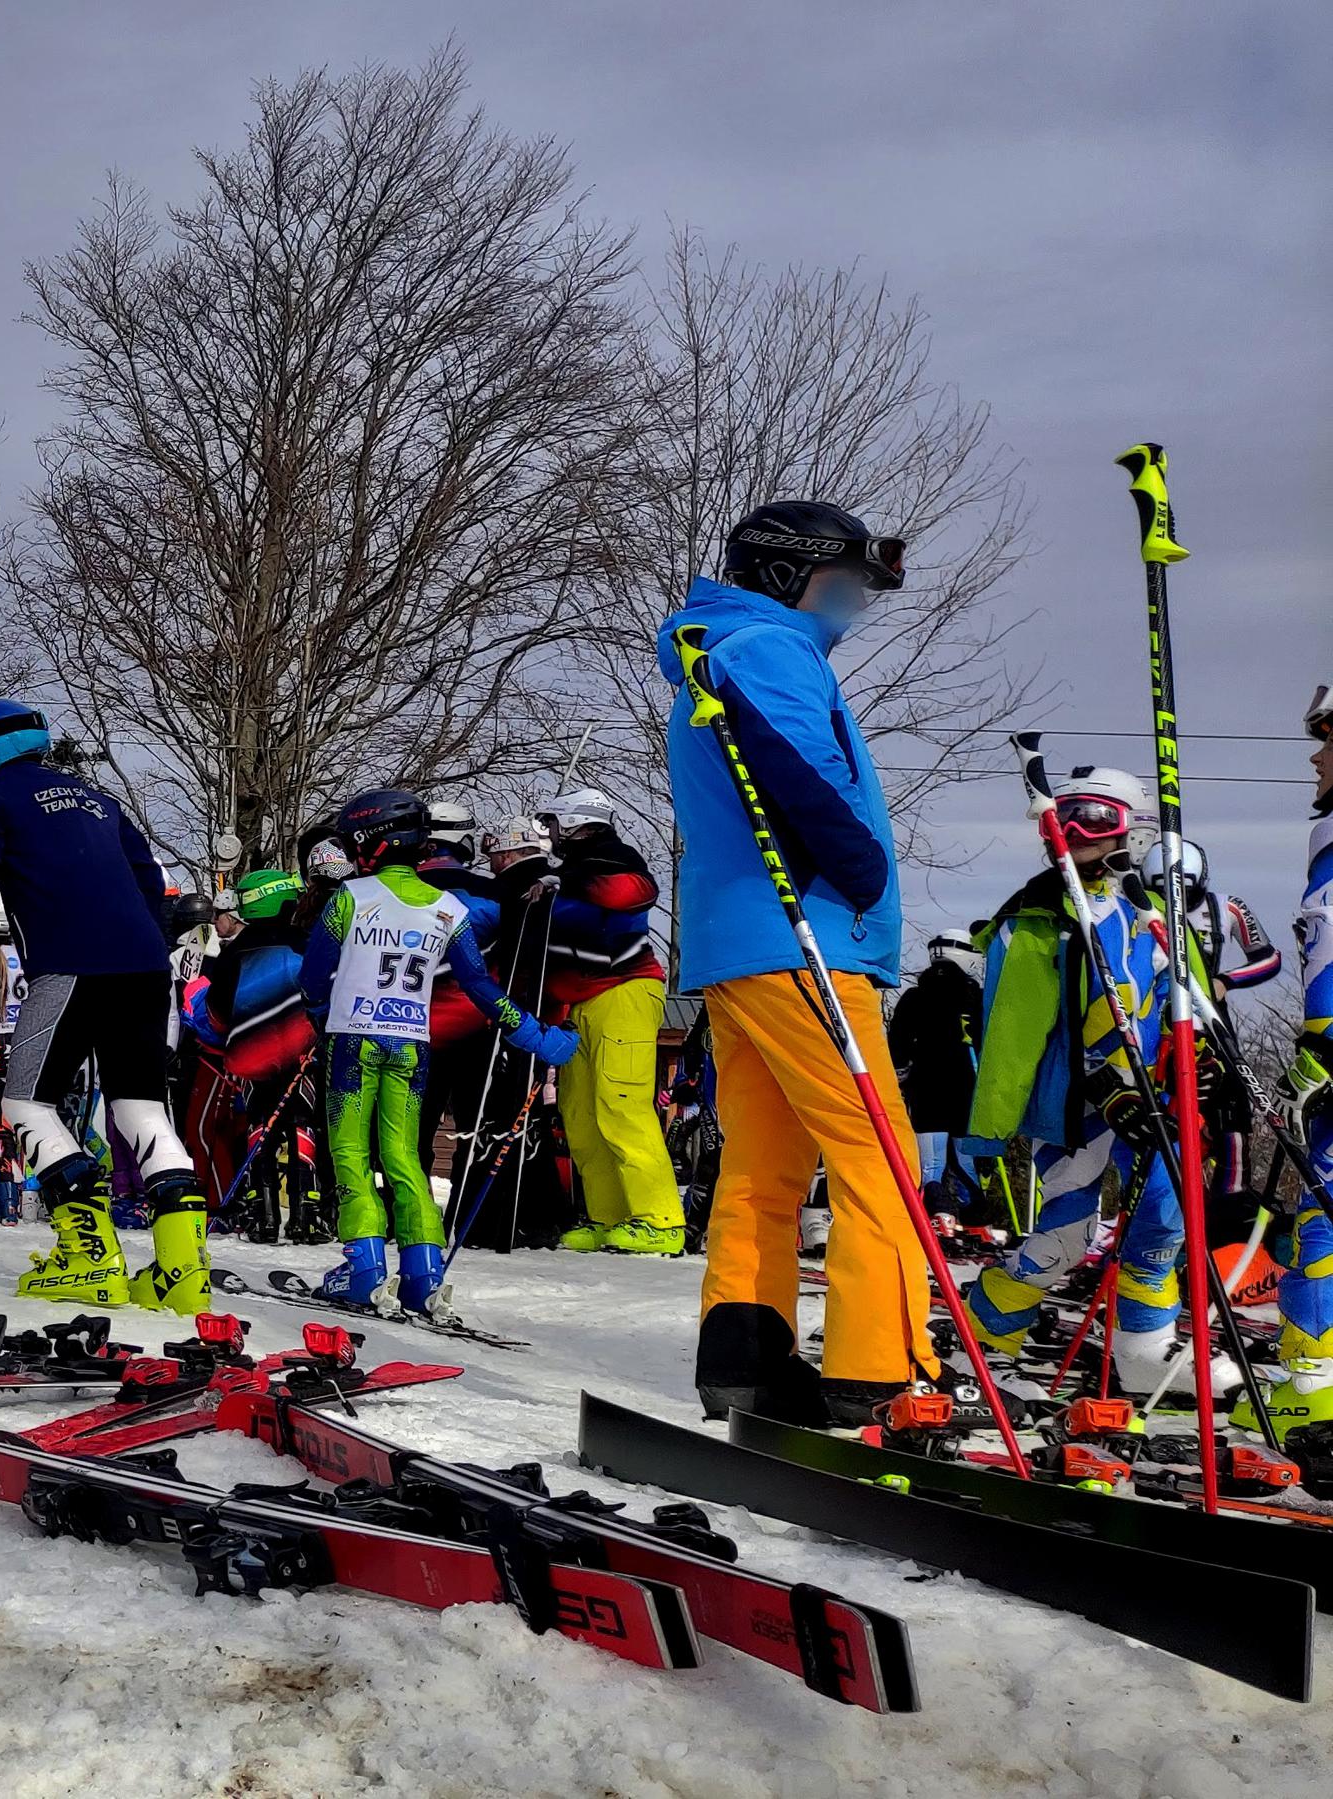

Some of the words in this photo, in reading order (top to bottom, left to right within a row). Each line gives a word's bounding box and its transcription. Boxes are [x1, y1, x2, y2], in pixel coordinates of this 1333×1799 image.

[1155, 500, 1167, 540] LEKI
[738, 528, 846, 554] BLIZZARD
[1156, 710, 1180, 807] LEKI
[34, 787, 73, 802] CZECH
[40, 798, 79, 814] TEAM
[368, 822, 394, 835] SCOTT
[753, 829, 797, 904] LEKI
[353, 926, 444, 956] MINOLTA
[377, 951, 430, 992] 55
[378, 1000, 426, 1021] ČSOB
[1236, 1063, 1279, 1117] SPARK
[26, 1267, 121, 1290] FISCHER
